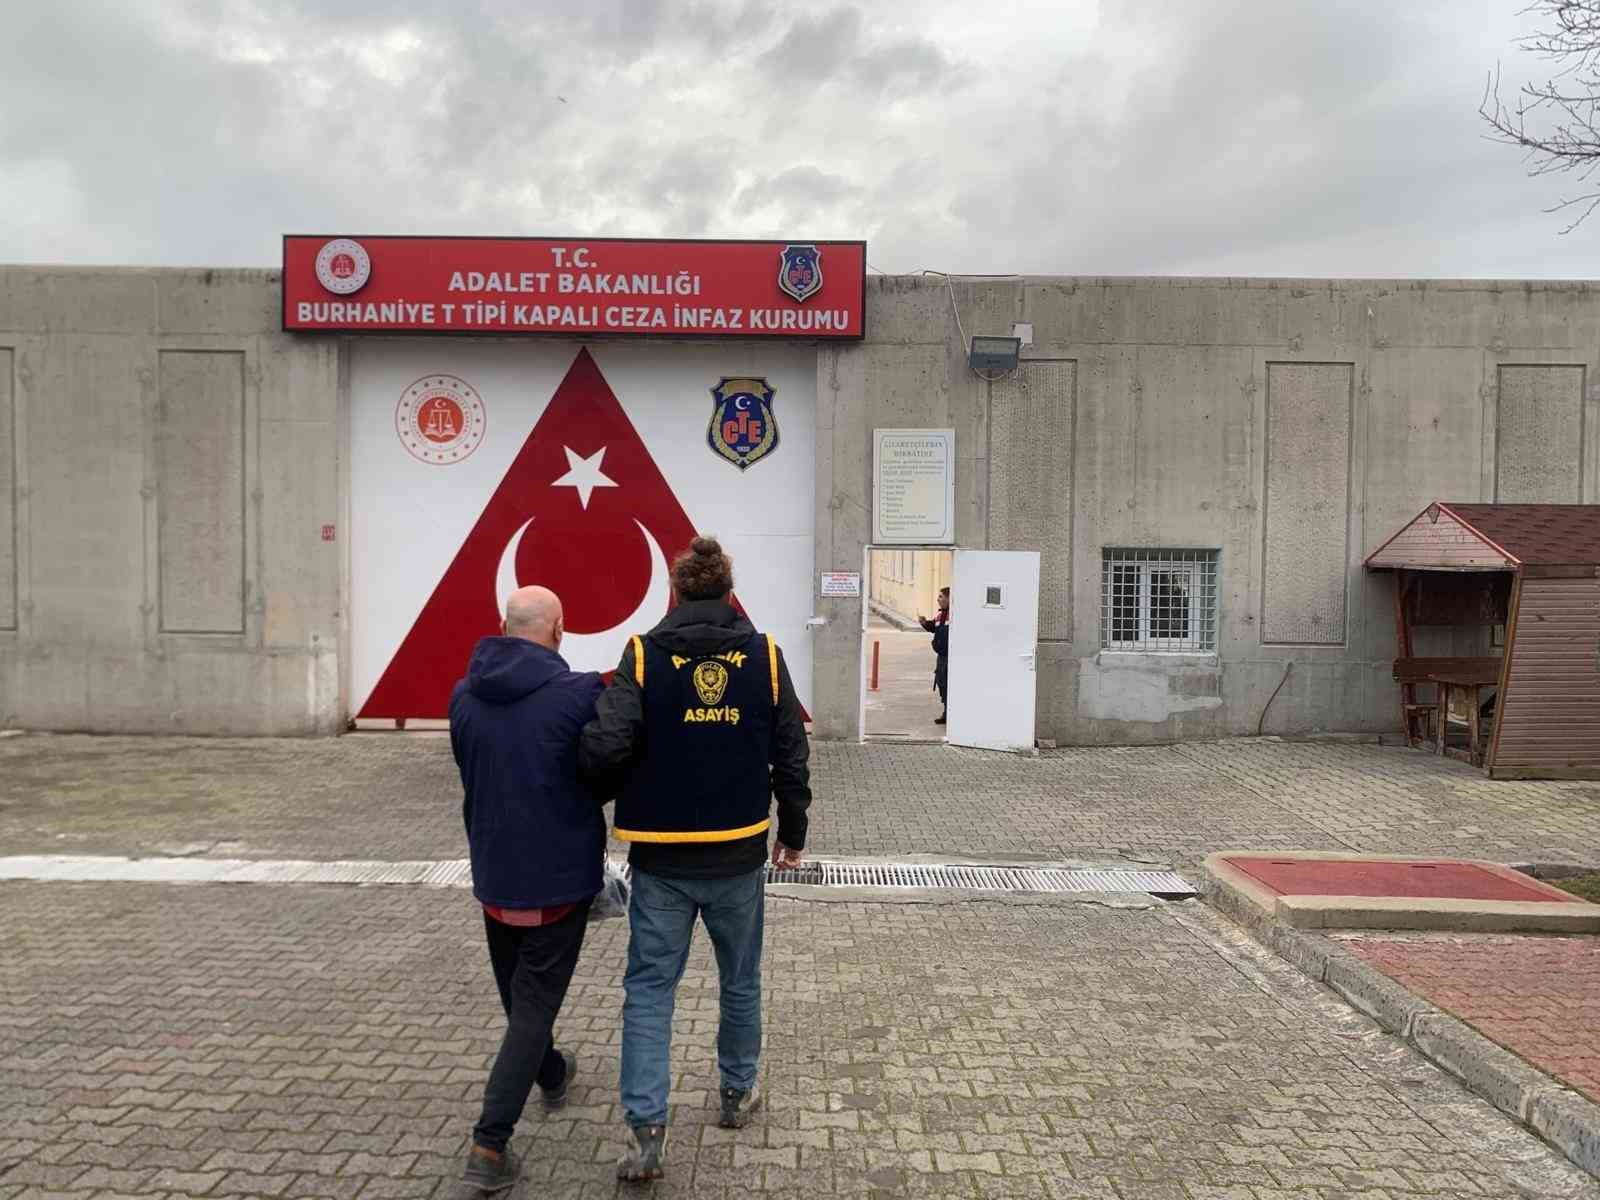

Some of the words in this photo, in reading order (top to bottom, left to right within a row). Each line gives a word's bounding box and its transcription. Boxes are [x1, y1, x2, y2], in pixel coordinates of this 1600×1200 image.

[551, 247, 597, 268] T.C.
[448, 271, 550, 293] ADALET
[558, 270, 700, 295] BAKANLIĞI
[298, 299, 435, 324] BURHANİYE
[442, 303, 455, 324] T
[462, 300, 507, 325] TİPİ
[513, 304, 598, 326] KAPALI
[605, 306, 667, 327] CEZA
[673, 303, 743, 328] İNFAZ
[750, 308, 849, 330] KURUMU
[723, 411, 761, 444] CTE
[684, 705, 740, 725] ASAYİŞ
